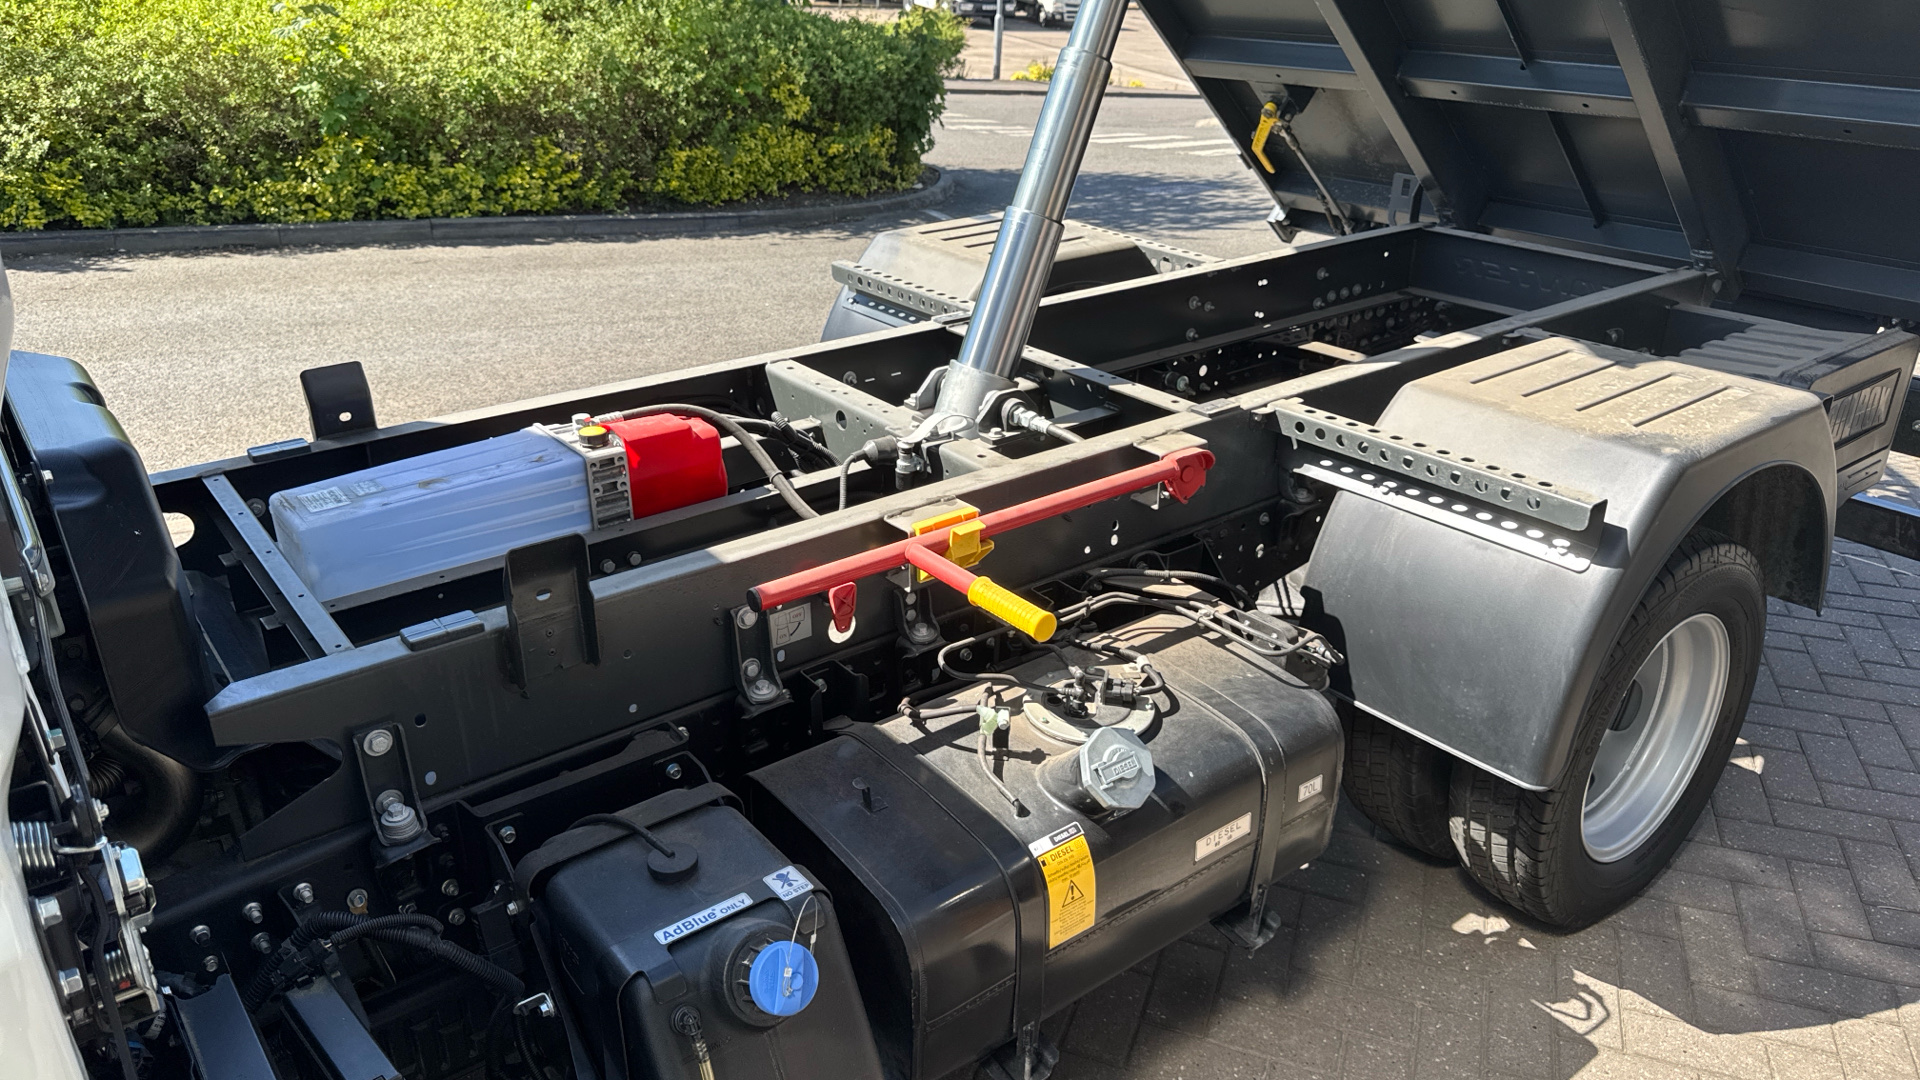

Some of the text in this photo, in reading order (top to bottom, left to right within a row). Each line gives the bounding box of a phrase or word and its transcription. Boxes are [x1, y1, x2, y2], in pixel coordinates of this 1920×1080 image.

[1303, 782, 1318, 797] 70L
[1206, 822, 1242, 847] DIESEL
[1049, 845, 1075, 862] DIESEL
[782, 882, 810, 899] NO STEP
[719, 897, 747, 916] ONLY
